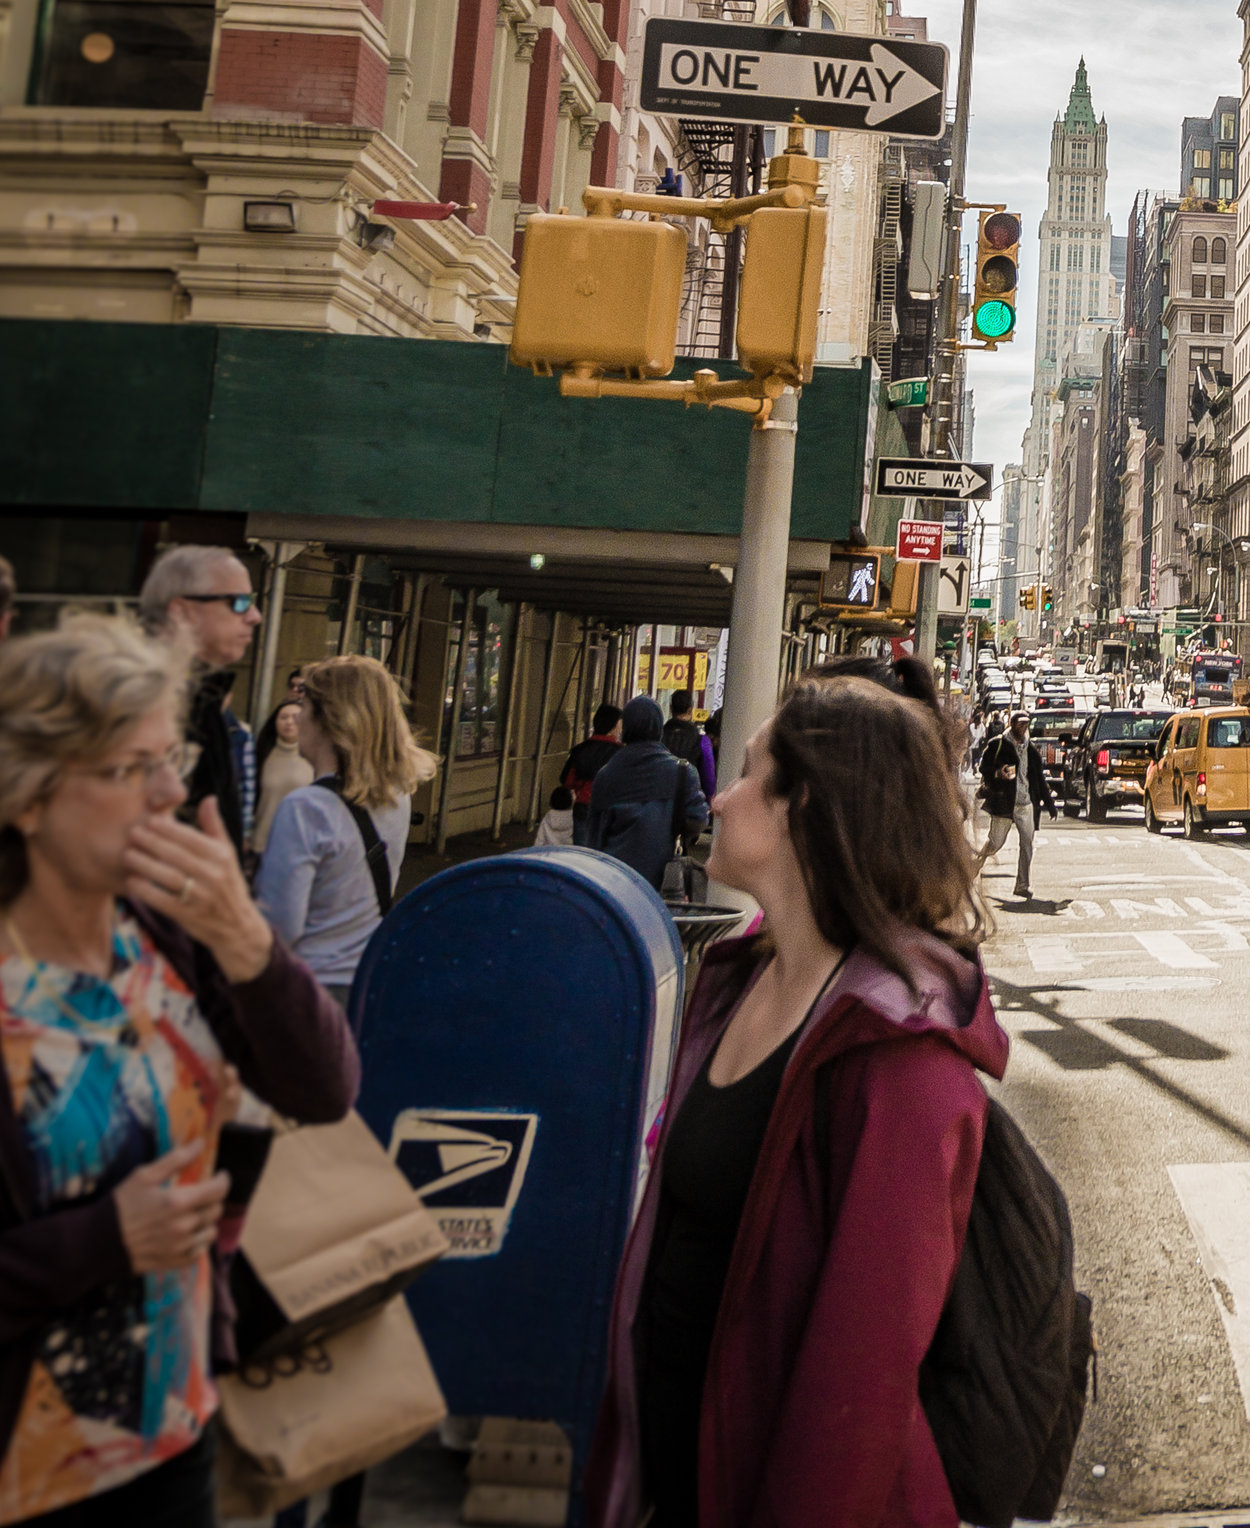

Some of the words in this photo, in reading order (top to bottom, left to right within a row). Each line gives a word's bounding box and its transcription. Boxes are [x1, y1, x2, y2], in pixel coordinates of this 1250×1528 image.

[670, 49, 760, 91] ONE
[813, 61, 906, 103] WAY
[914, 382, 925, 394] ST
[894, 471, 927, 486] ONE
[942, 472, 975, 488] WAY
[901, 524, 911, 533] NO
[912, 524, 941, 535] STANDING
[905, 534, 936, 546] ANYTIME
